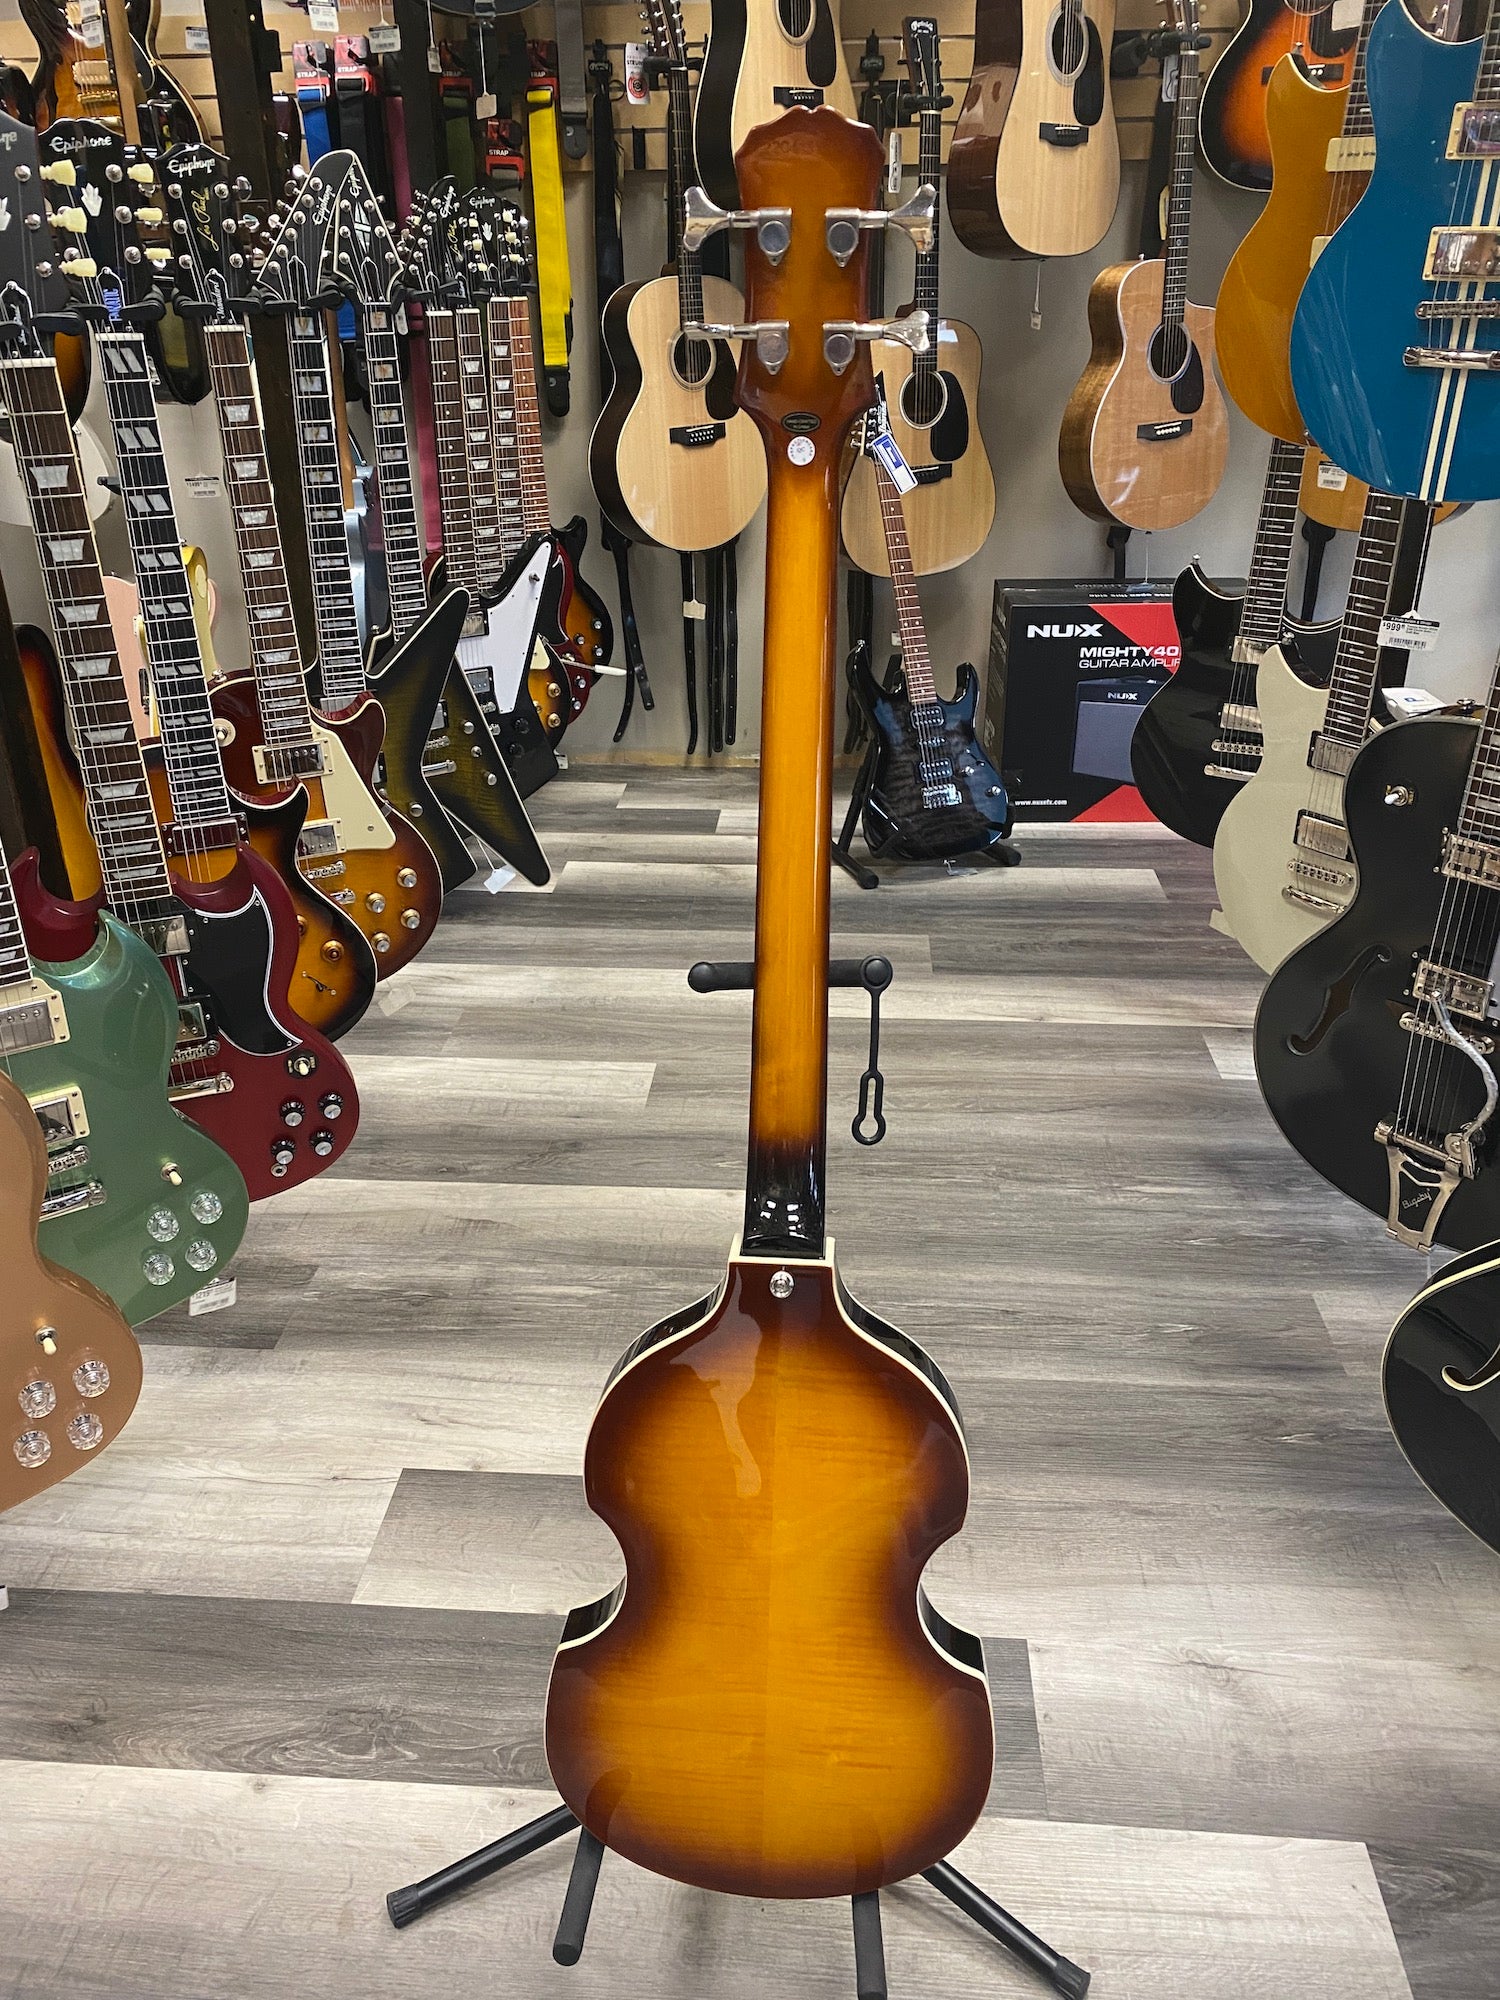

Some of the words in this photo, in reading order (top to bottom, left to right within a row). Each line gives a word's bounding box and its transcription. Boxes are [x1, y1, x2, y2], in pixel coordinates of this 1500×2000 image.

[49, 136, 113, 154] Epiphone
[166, 155, 216, 178] Epiphone
[312, 184, 336, 226] Epiphone
[1026, 623, 1104, 639] NUX
[1078, 658, 1129, 669] GUITAR
[1107, 691, 1139, 701] NUX
